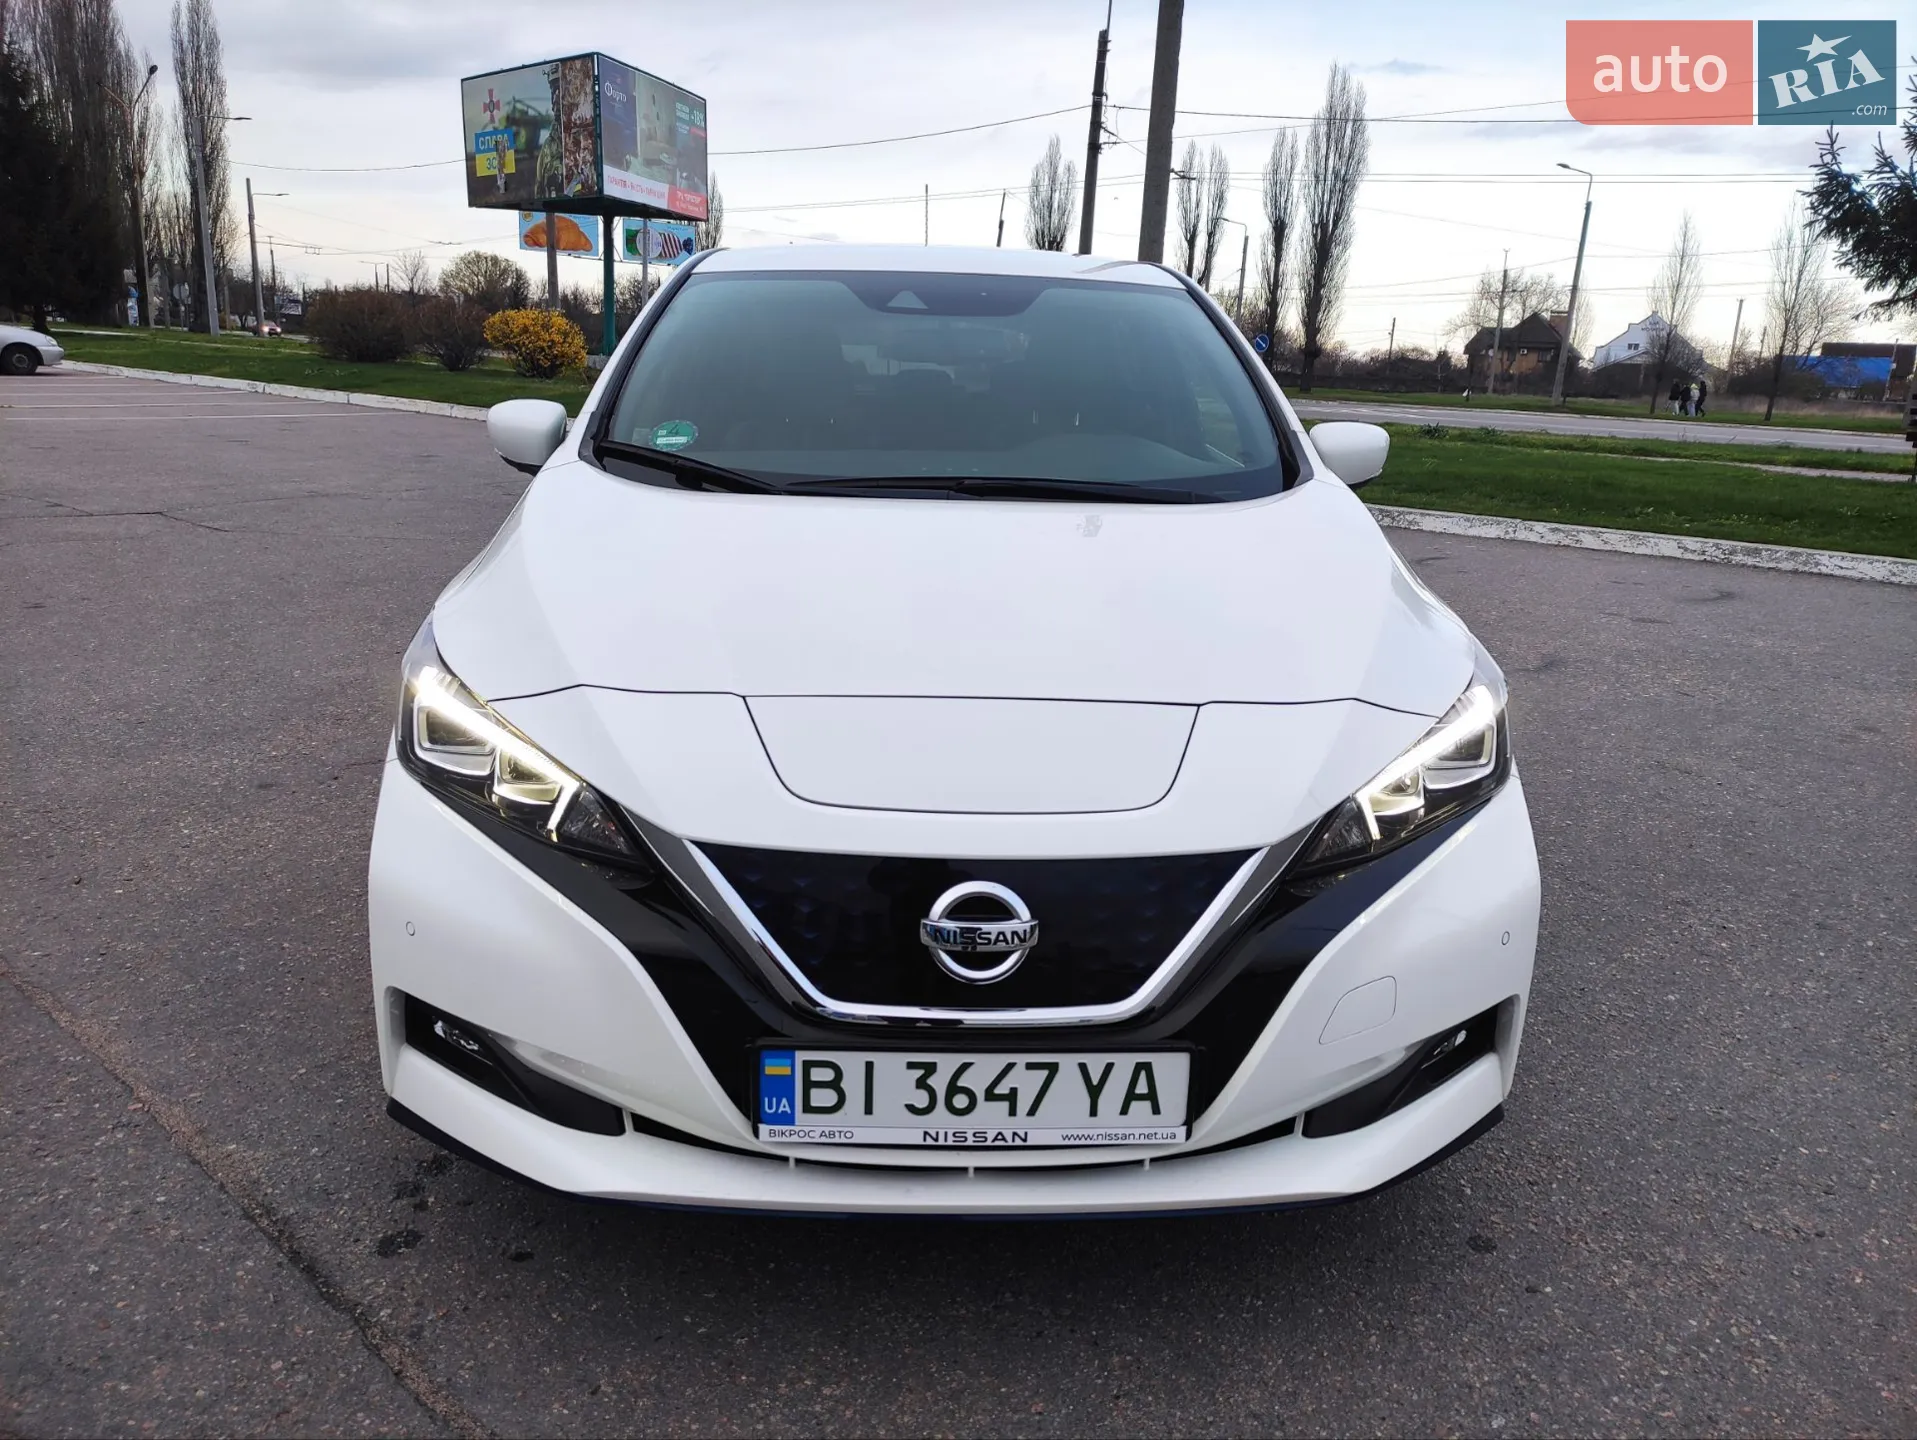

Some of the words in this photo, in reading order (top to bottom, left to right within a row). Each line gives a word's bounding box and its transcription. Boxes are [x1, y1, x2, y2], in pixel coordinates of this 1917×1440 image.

[932, 928, 1028, 946] NISSAN
[802, 1059, 875, 1116] BI
[904, 1060, 1060, 1117] 3647
[1077, 1061, 1162, 1118] YA
[764, 1096, 792, 1114] UA
[768, 1128, 817, 1139] ВІКРОС
[819, 1129, 855, 1140] АВТО
[923, 1130, 1029, 1144] NISSAN
[1061, 1131, 1178, 1141] www.nissan.net.ua
